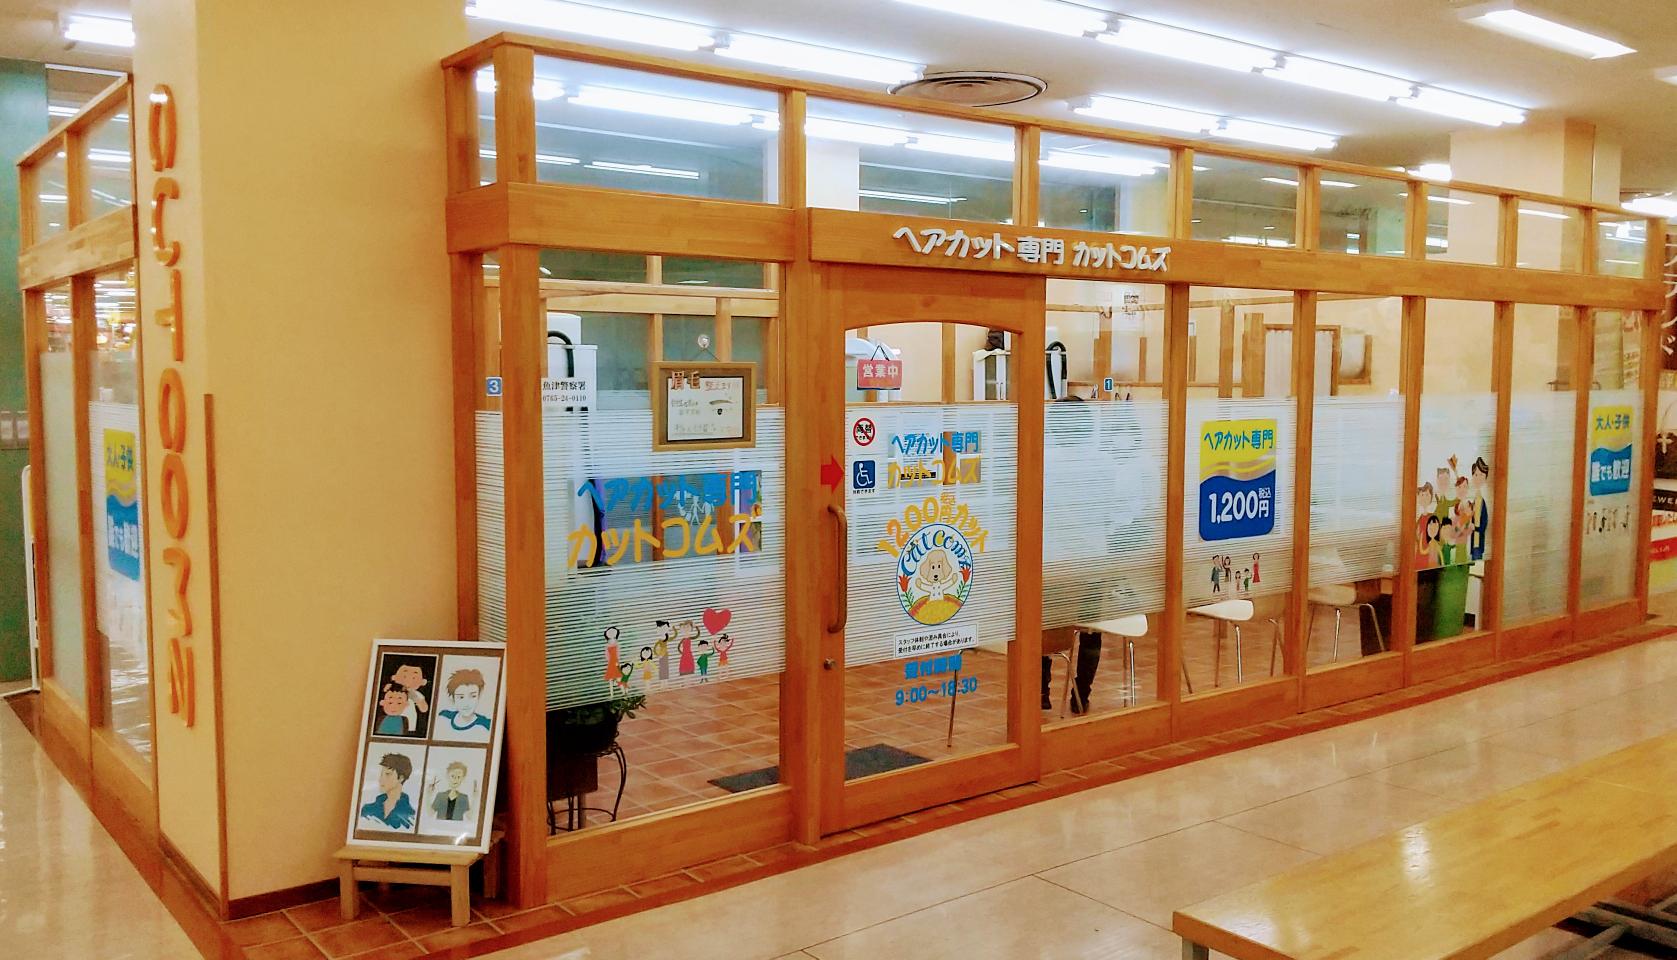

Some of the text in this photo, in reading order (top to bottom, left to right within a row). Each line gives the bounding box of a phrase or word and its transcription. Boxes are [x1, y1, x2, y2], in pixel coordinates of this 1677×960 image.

[892, 226, 1172, 273] ヘアカット専門 カットコムズ
[863, 363, 899, 379] 営業中
[488, 379, 499, 393] 3
[542, 380, 587, 391] 魚津警察署
[891, 431, 979, 455] ヘアカット専門
[1203, 429, 1274, 451] ヘアカット専門
[577, 470, 760, 513] ヘアカット専門
[566, 506, 763, 570] カットコムズ
[904, 653, 963, 680] 受付時間
